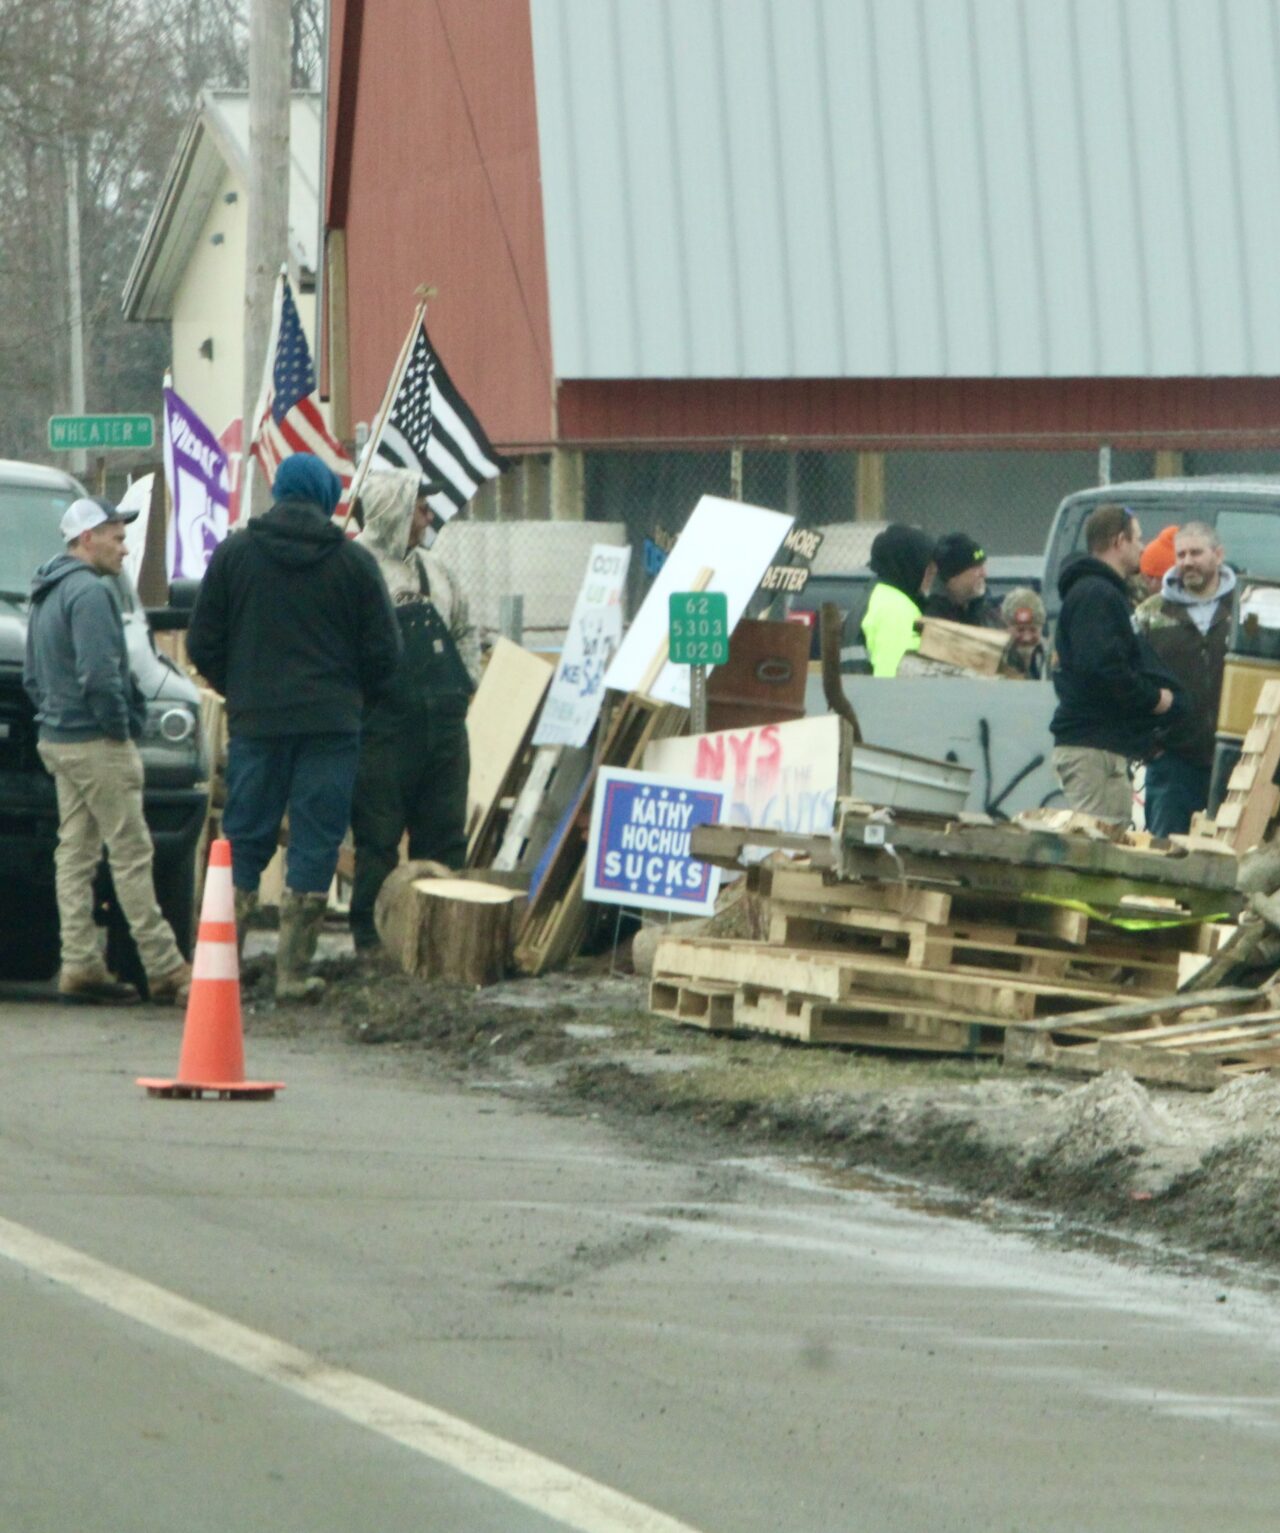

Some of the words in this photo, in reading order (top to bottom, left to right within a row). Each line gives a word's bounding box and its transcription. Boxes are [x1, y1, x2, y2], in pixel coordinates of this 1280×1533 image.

[54, 421, 133, 443] WHEATER
[783, 528, 821, 560] MORE
[686, 598, 709, 615] 62
[672, 620, 723, 637] 5303
[674, 641, 723, 659] 1020
[694, 724, 783, 781] NYS
[631, 796, 694, 830] KATHY
[604, 850, 703, 889] SUCKS
